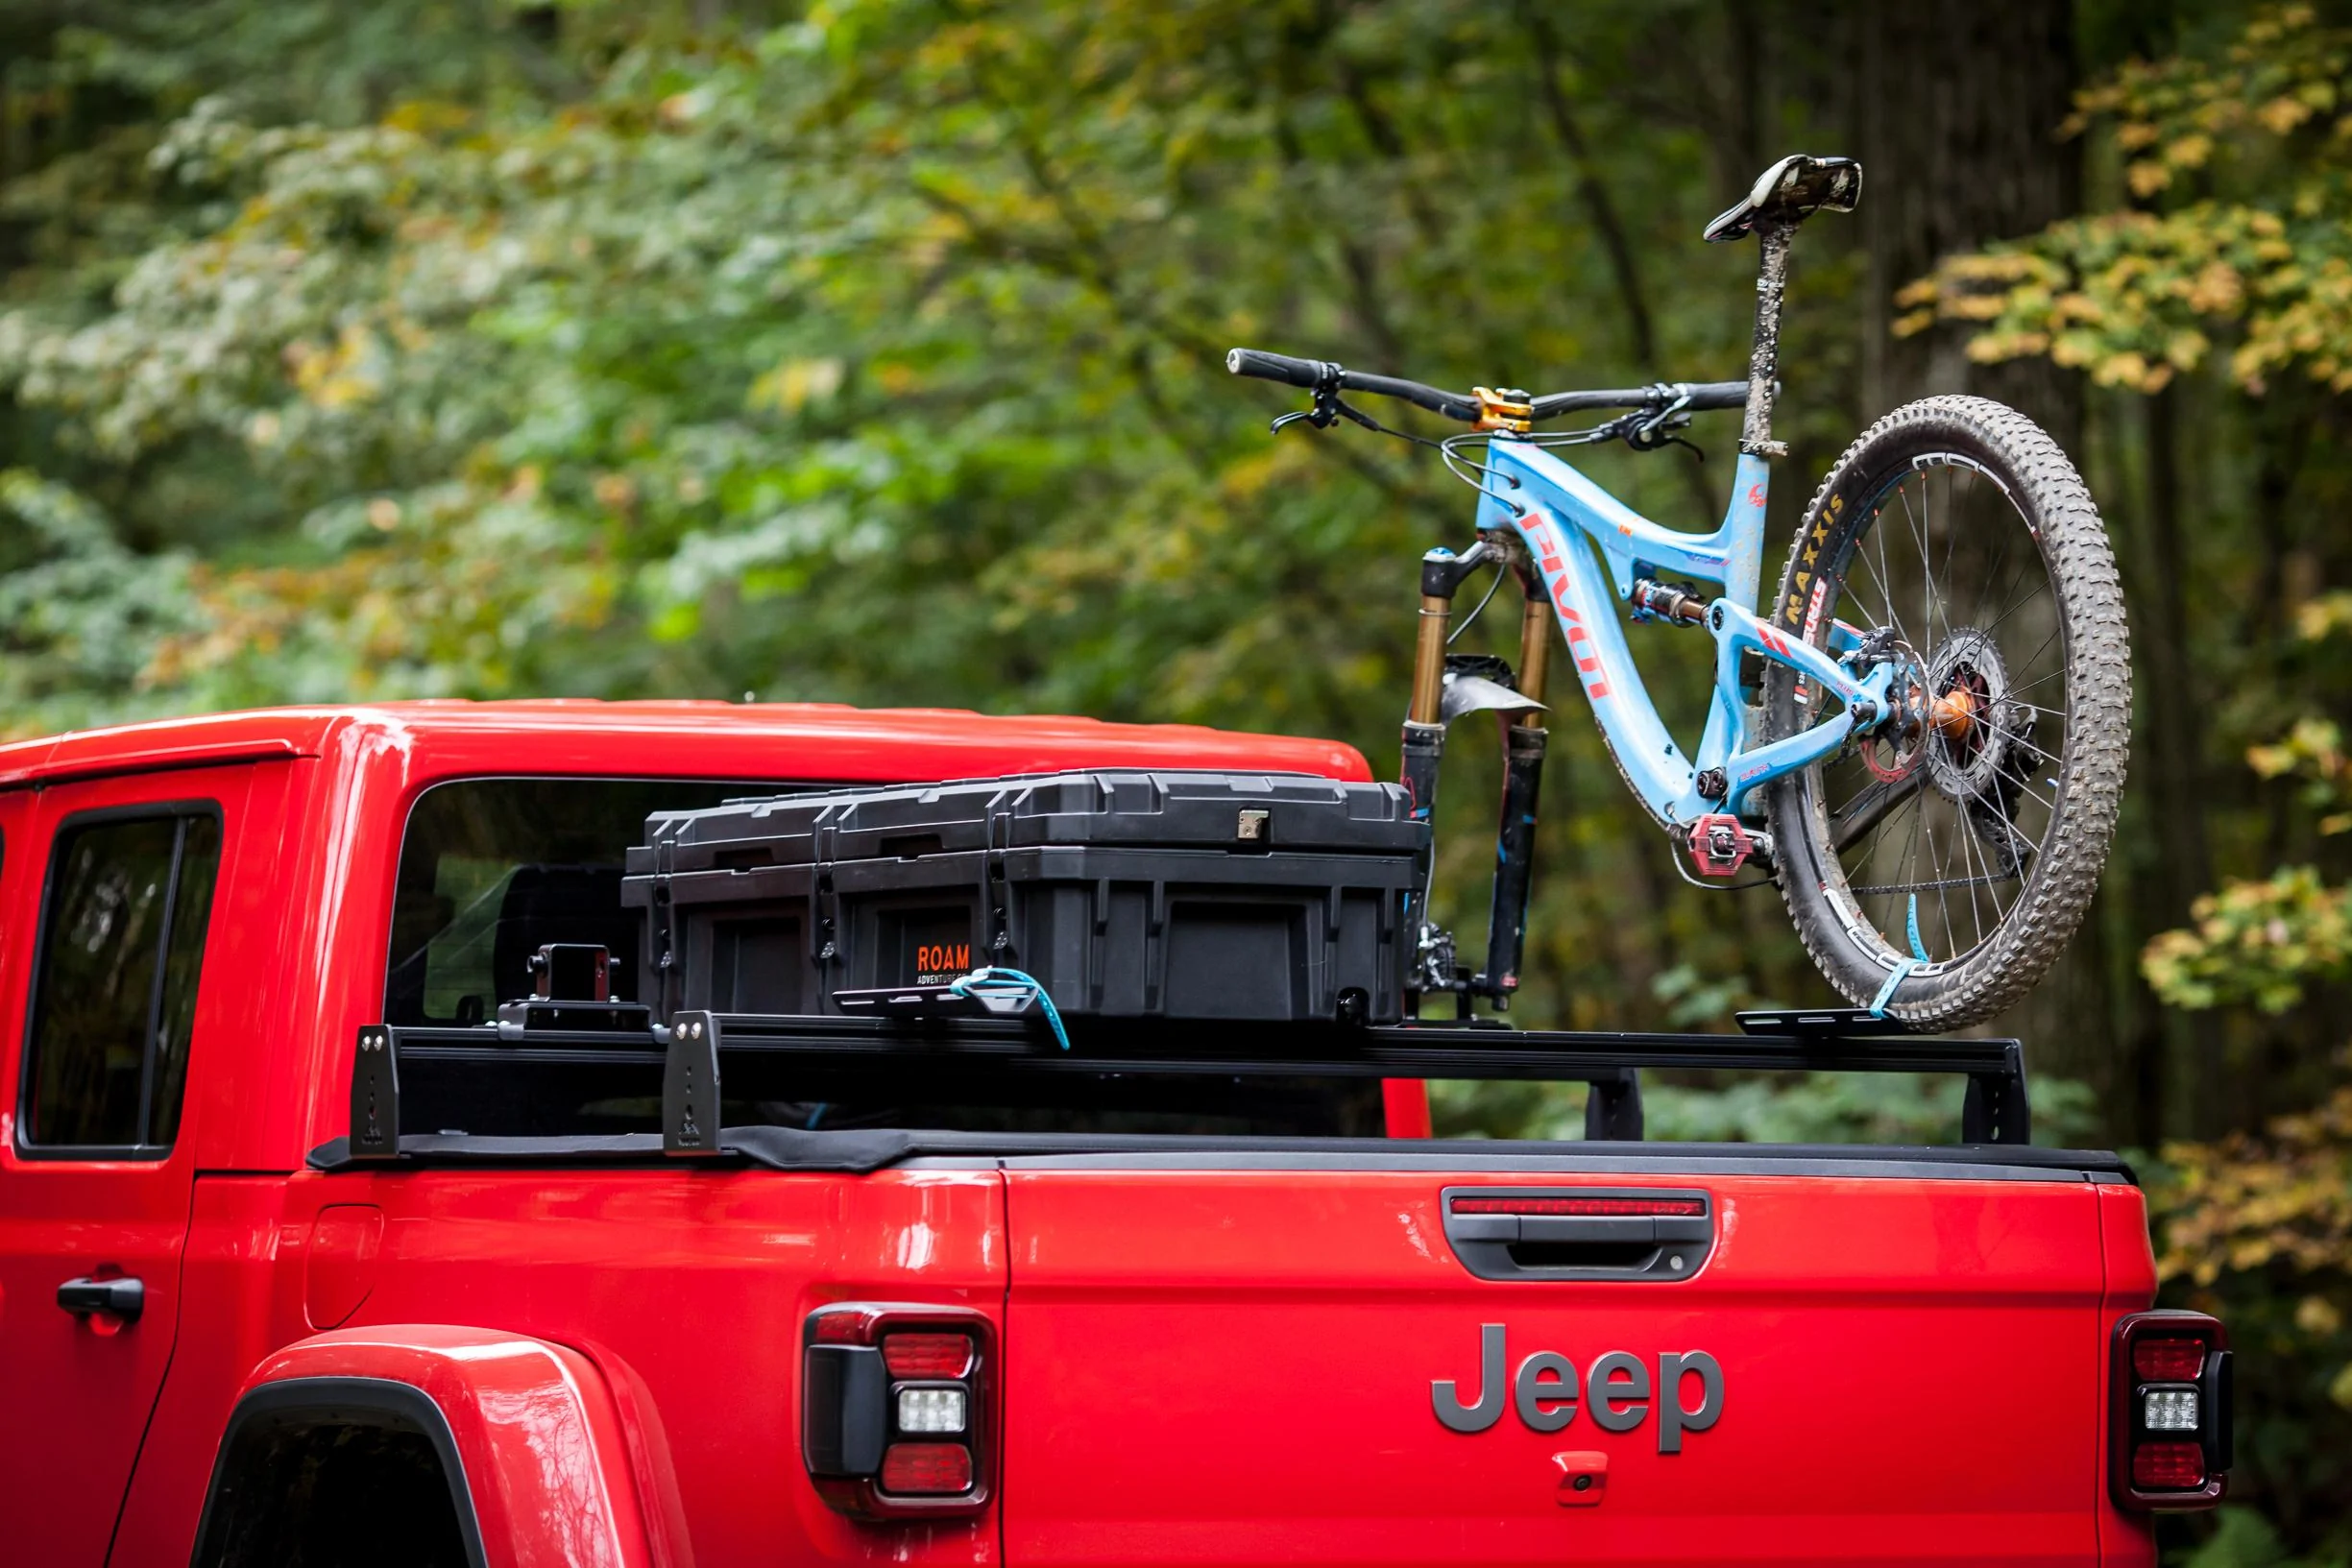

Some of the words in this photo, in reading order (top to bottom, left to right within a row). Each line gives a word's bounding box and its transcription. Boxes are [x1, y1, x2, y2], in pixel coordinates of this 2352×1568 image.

[1519, 513, 1612, 701] PIVOT
[1786, 494, 1843, 625] MAXXIS
[917, 944, 969, 972] ROAM
[1431, 1322, 1725, 1454] Jeep
